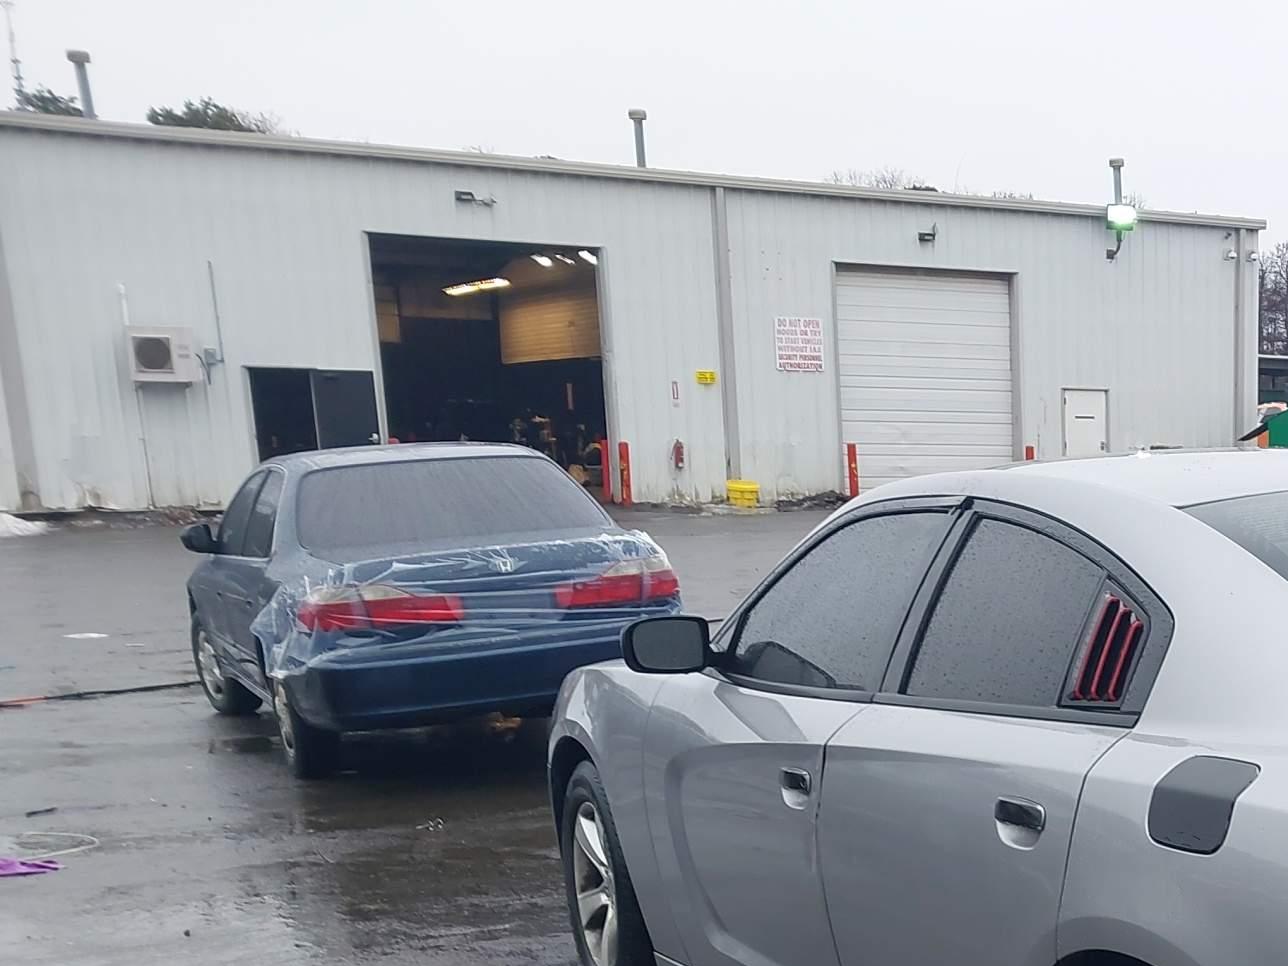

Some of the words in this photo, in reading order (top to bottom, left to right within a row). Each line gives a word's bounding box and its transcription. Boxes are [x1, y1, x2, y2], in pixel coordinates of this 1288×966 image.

[777, 318, 787, 327] DO
[788, 318, 801, 328] NOT
[802, 319, 820, 329] OPEN
[810, 329, 821, 337] TRY
[777, 345, 808, 353] WITHOUT
